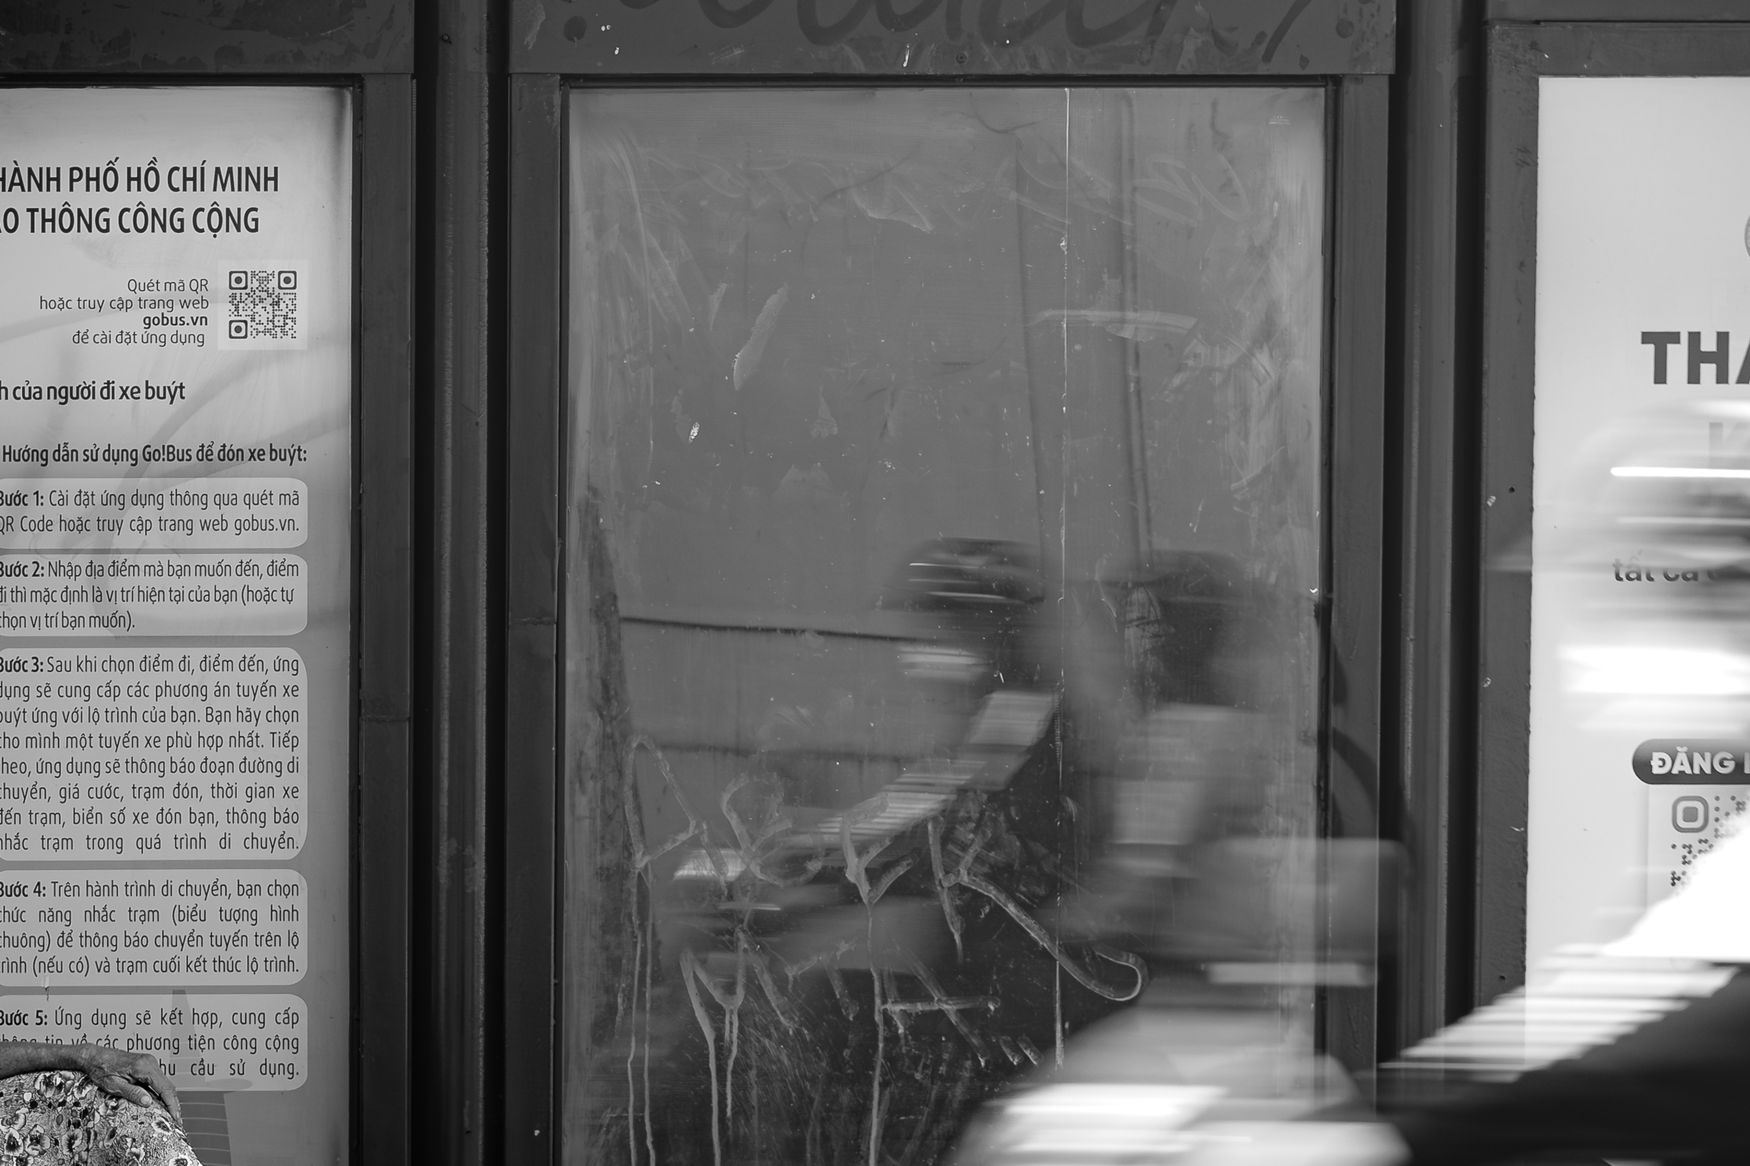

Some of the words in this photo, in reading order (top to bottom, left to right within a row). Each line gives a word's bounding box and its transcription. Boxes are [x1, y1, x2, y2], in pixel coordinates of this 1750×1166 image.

[69, 157, 119, 192] PHỐ
[127, 157, 160, 192] HỒ
[168, 160, 206, 192] CHÍ
[213, 167, 278, 192] MINH
[26, 201, 110, 233] THÔNG
[118, 201, 184, 233] CÔNG
[192, 201, 258, 238] CỘNG
[128, 279, 160, 294] Quét
[164, 279, 185, 292] mã
[189, 279, 208, 294] QR
[40, 296, 72, 311] hoặc
[77, 297, 104, 313] truy
[110, 297, 133, 312] cập
[138, 297, 174, 313] trang
[179, 295, 209, 309] web
[143, 312, 207, 329] gobus.vn
[72, 329, 89, 344] để
[93, 330, 111, 344] cài
[115, 330, 137, 345] đặt
[141, 331, 166, 347] ứng
[170, 330, 204, 347] dụng
[1641, 331, 1750, 385] TH
[13, 380, 42, 400] của
[47, 381, 96, 405] người
[100, 380, 115, 400] đi
[119, 386, 141, 400] xe
[145, 380, 185, 405] buýt
[3, 445, 48, 467] Hướng
[52, 442, 78, 462] dẫn
[83, 443, 100, 462] sử
[102, 444, 138, 467] dụng
[142, 445, 192, 462] Go!Bus
[196, 441, 214, 461] để
[217, 443, 244, 461] đón
[248, 448, 266, 461] xe
[270, 443, 306, 466] buýt:
[33, 490, 44, 506] 1:
[49, 490, 68, 506] Cài
[74, 489, 95, 508] đặt
[101, 490, 125, 511] ứng
[131, 489, 164, 510] dụng
[170, 489, 208, 510] thông
[214, 493, 237, 510] qua
[243, 489, 273, 510] quét
[279, 490, 299, 506] mã
[1650, 746, 1735, 775] ĐĂNG
